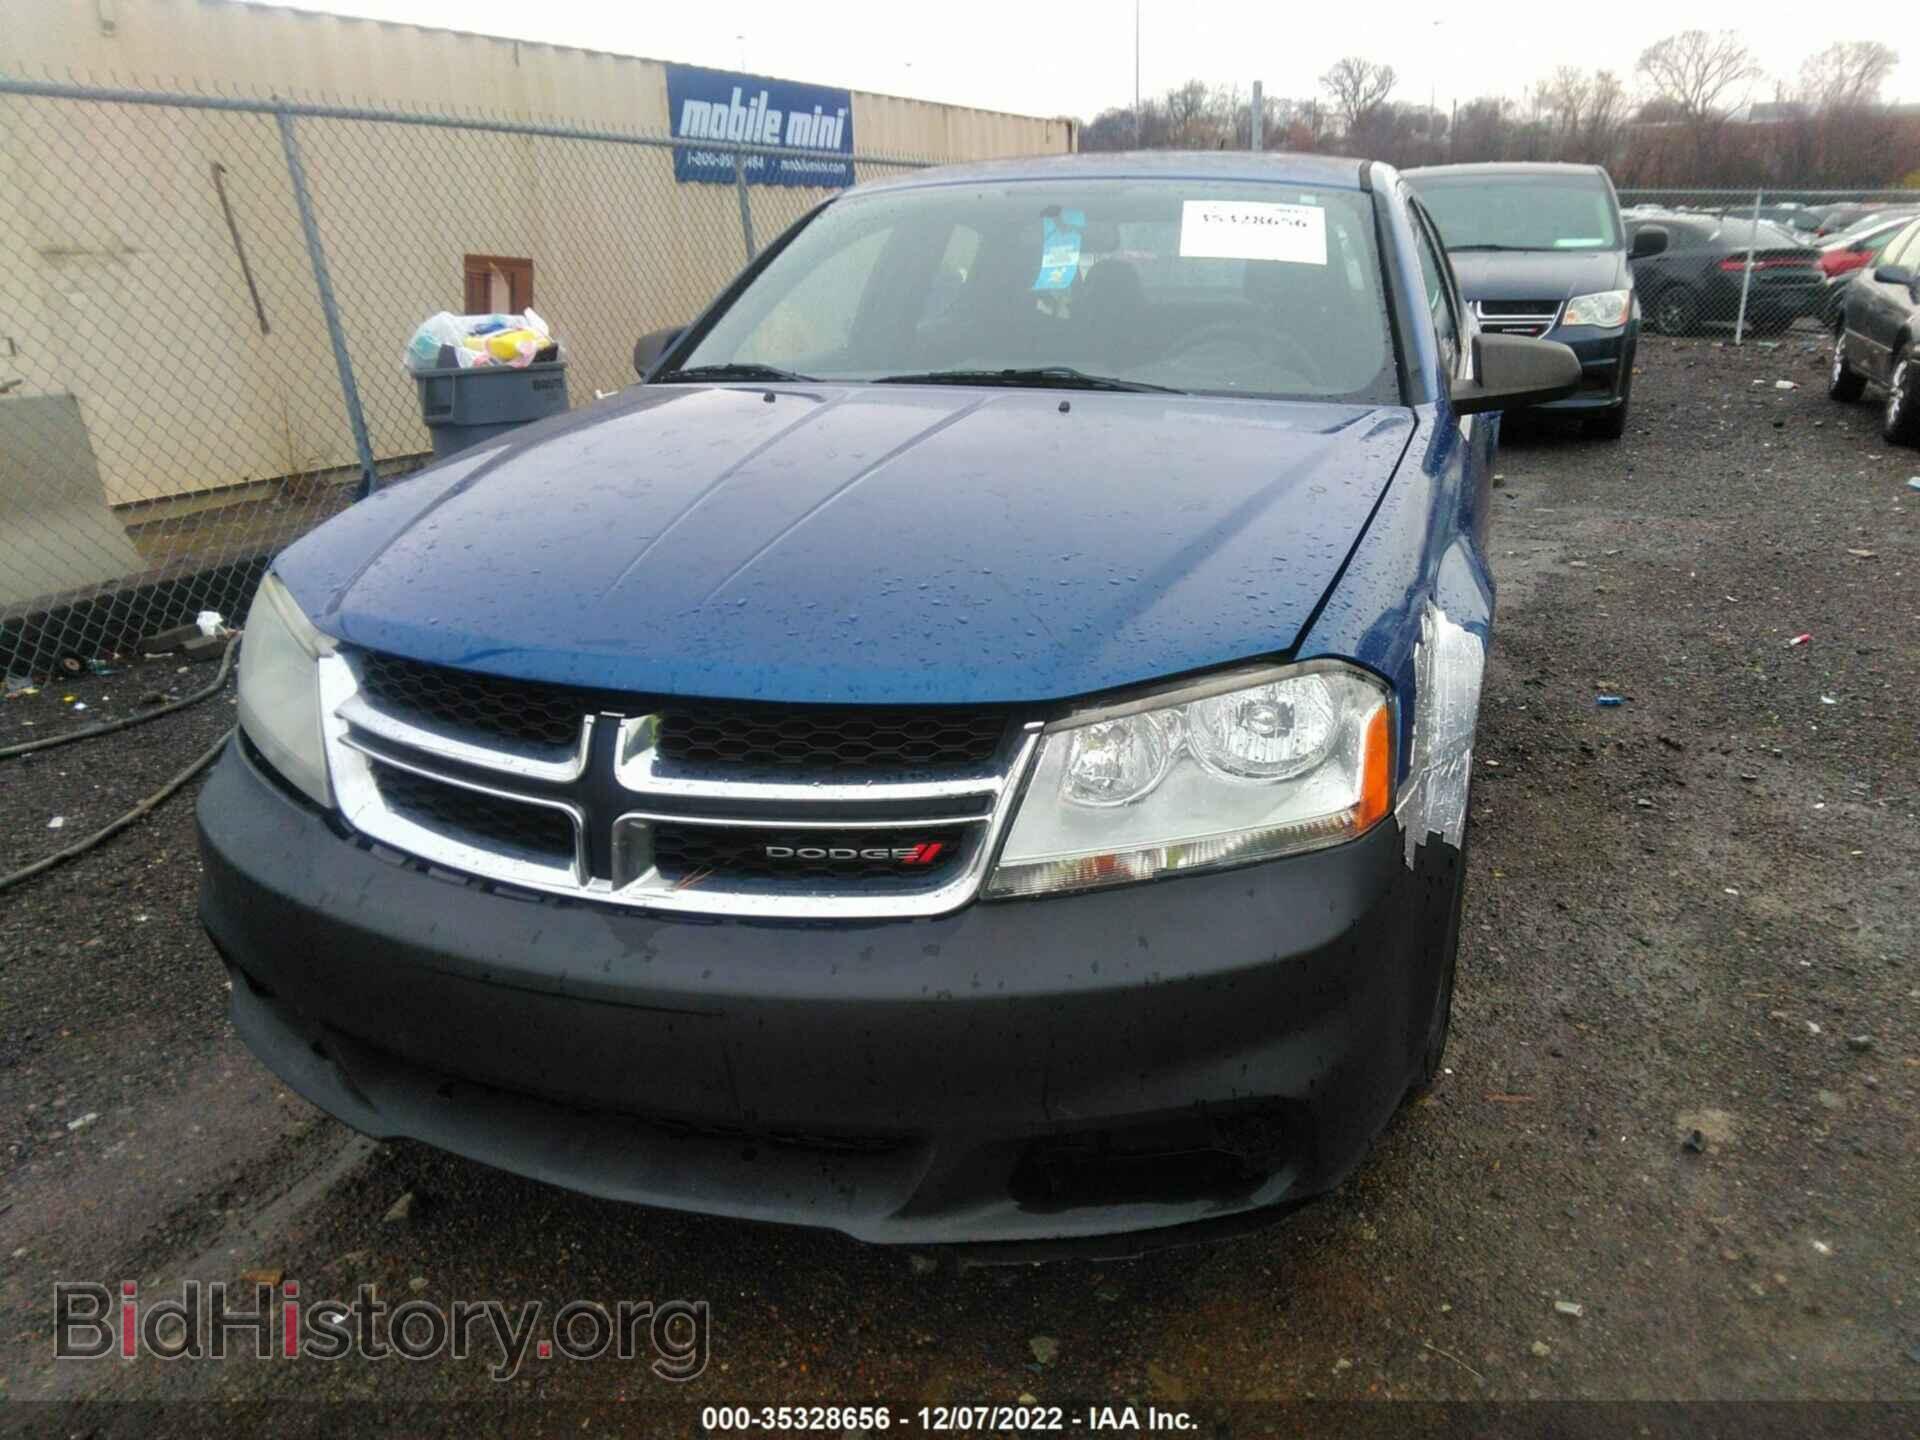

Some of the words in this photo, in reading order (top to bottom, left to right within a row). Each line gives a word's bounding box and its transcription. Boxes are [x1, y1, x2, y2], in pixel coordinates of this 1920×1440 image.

[679, 86, 783, 145] mobile
[785, 104, 846, 149] mini
[766, 846, 919, 860] DODGE
